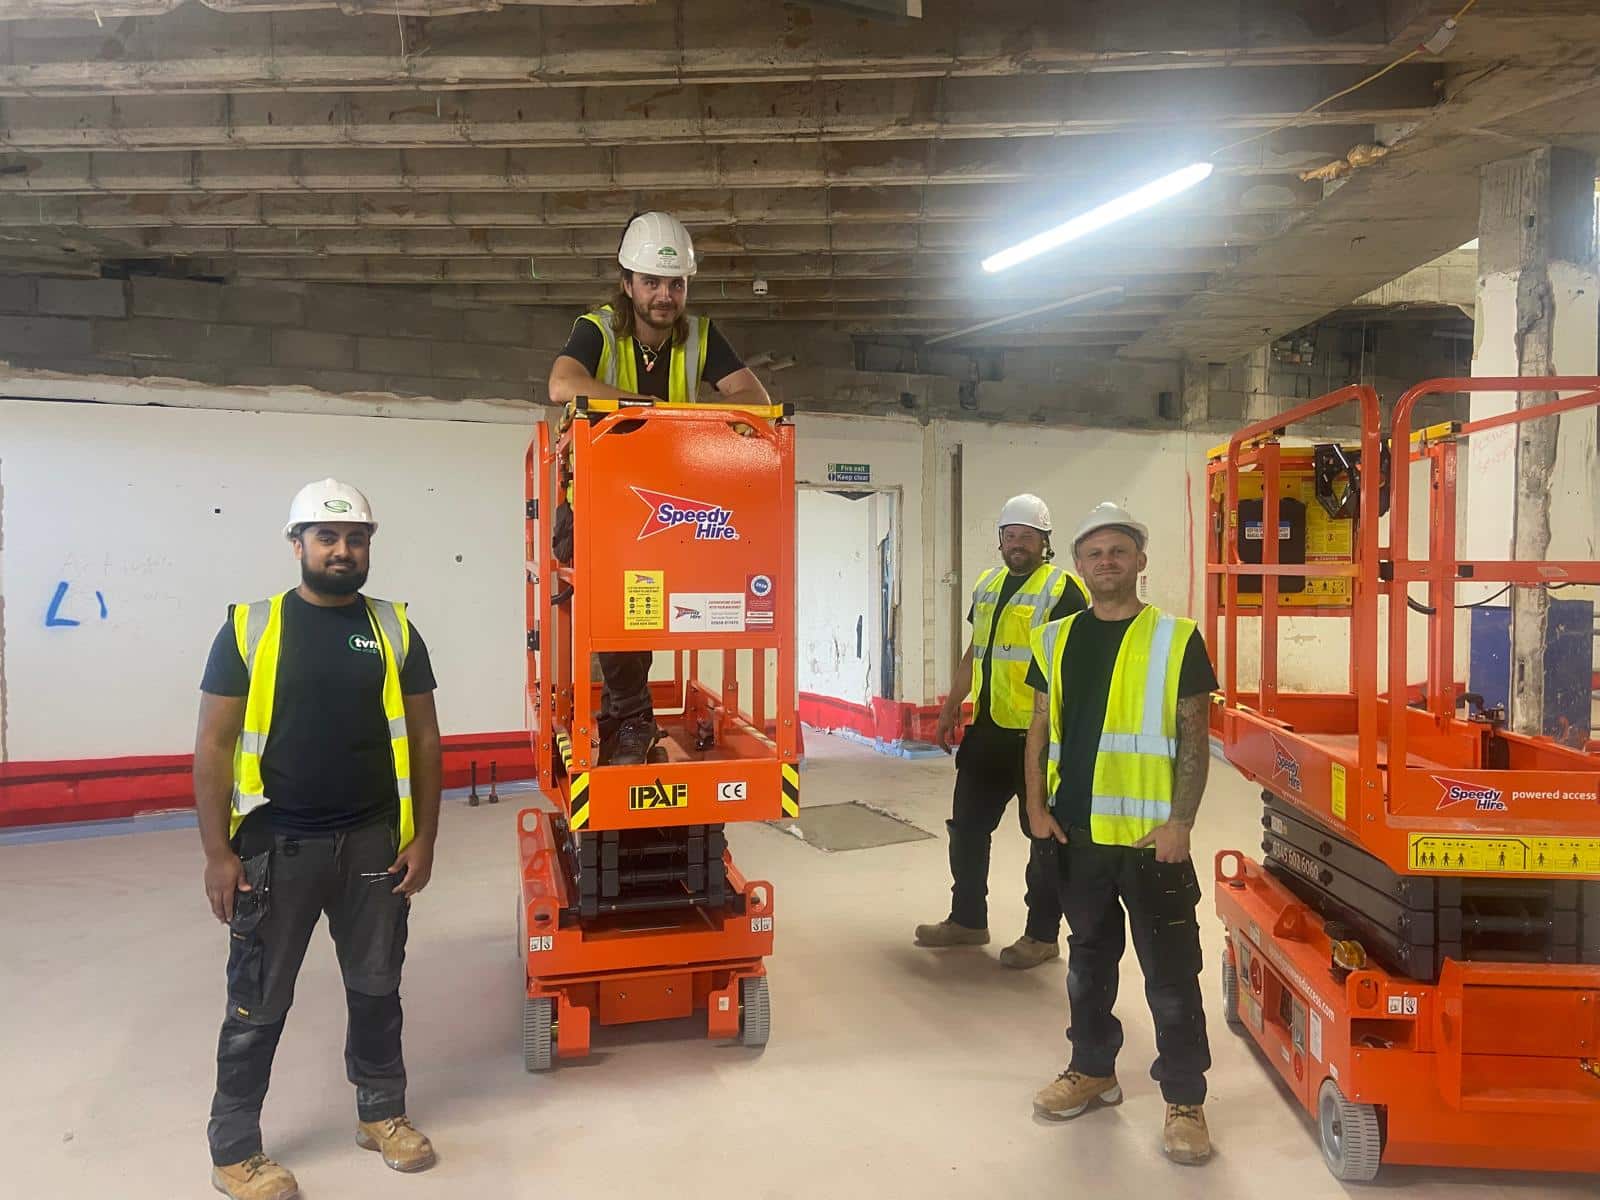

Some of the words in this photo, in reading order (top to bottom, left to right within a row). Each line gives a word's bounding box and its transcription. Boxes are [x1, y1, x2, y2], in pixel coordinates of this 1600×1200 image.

[840, 464, 853, 472] Fire
[836, 473, 853, 481] Keep
[657, 503, 732, 527] Speedy
[630, 779, 686, 809] IPAF
[722, 783, 743, 798] CE
[1450, 786, 1501, 801] Speedy
[1512, 790, 1560, 801] powered
[1562, 792, 1597, 800] access
